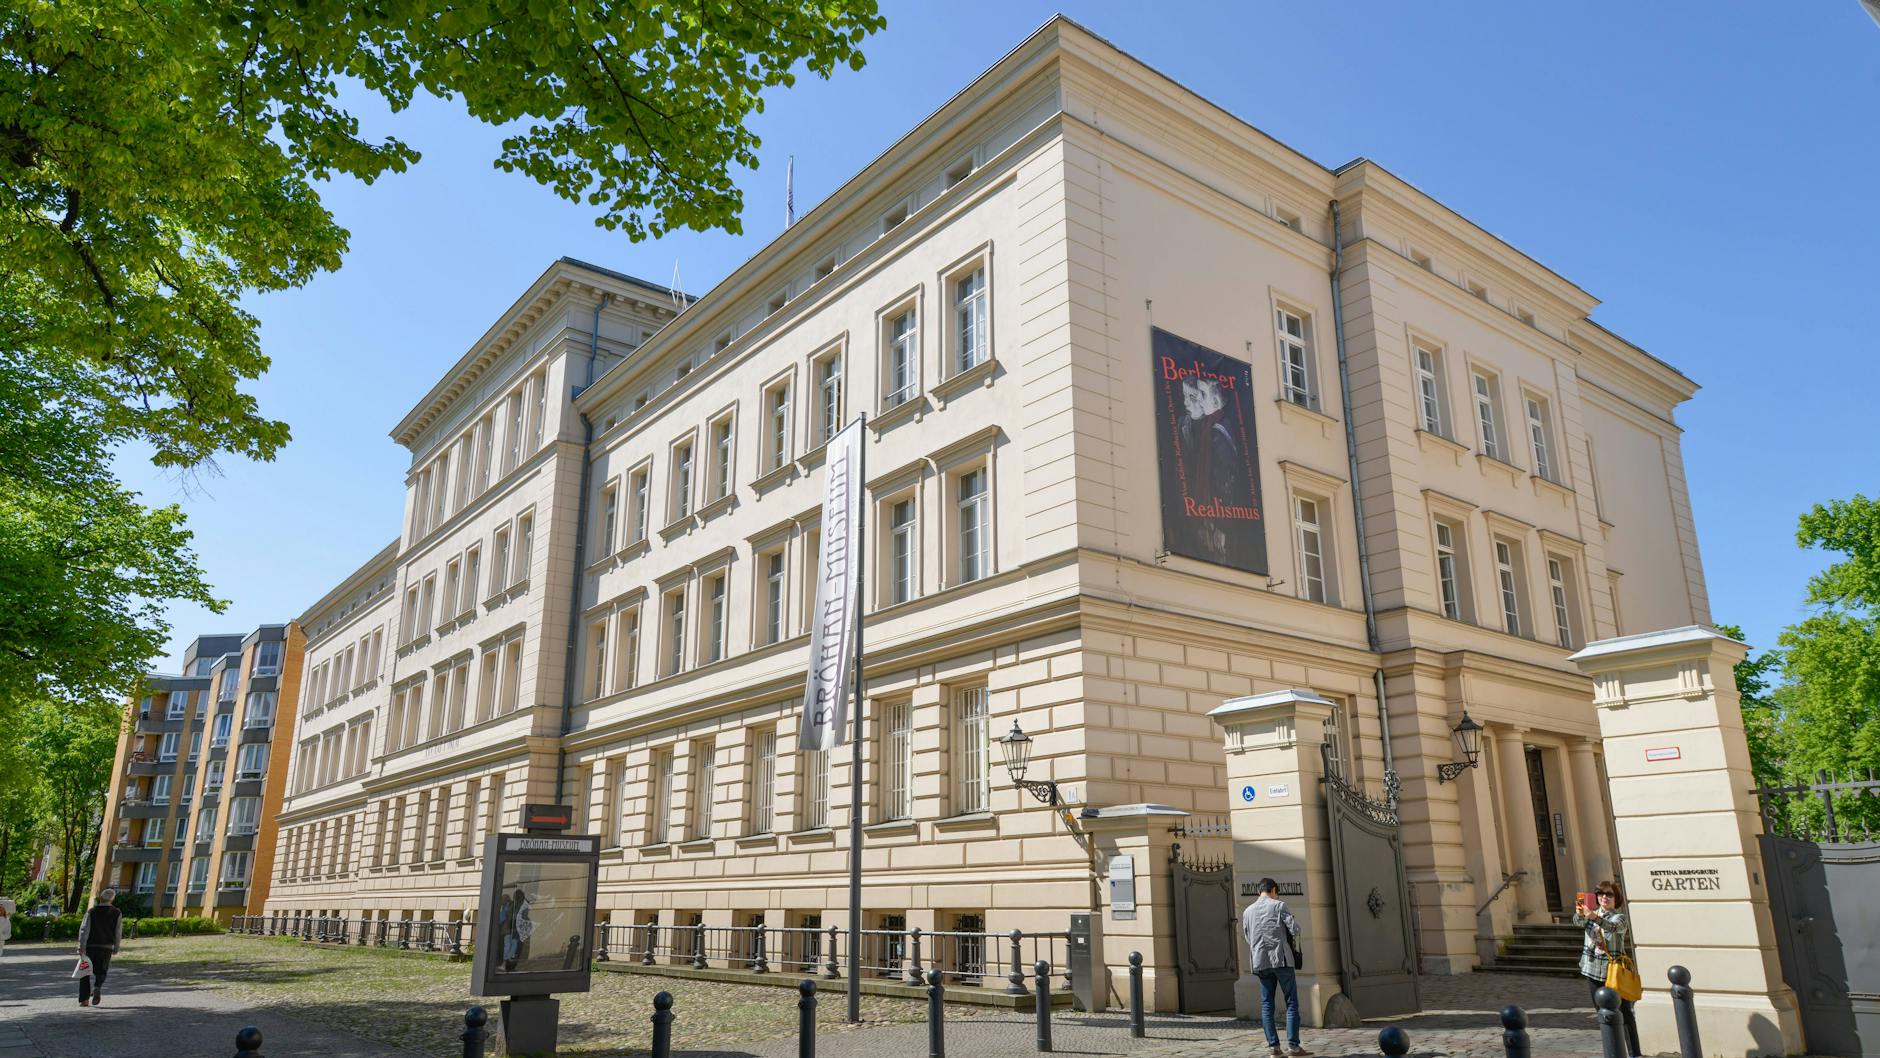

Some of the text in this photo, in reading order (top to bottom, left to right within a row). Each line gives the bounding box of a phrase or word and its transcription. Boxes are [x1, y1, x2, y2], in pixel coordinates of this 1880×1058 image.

[1161, 355, 1236, 389] Berliner
[1184, 496, 1260, 520] Realismus
[813, 457, 846, 727] BRÖHAN-MUSEUM
[1652, 877, 1721, 891] GARTEN
